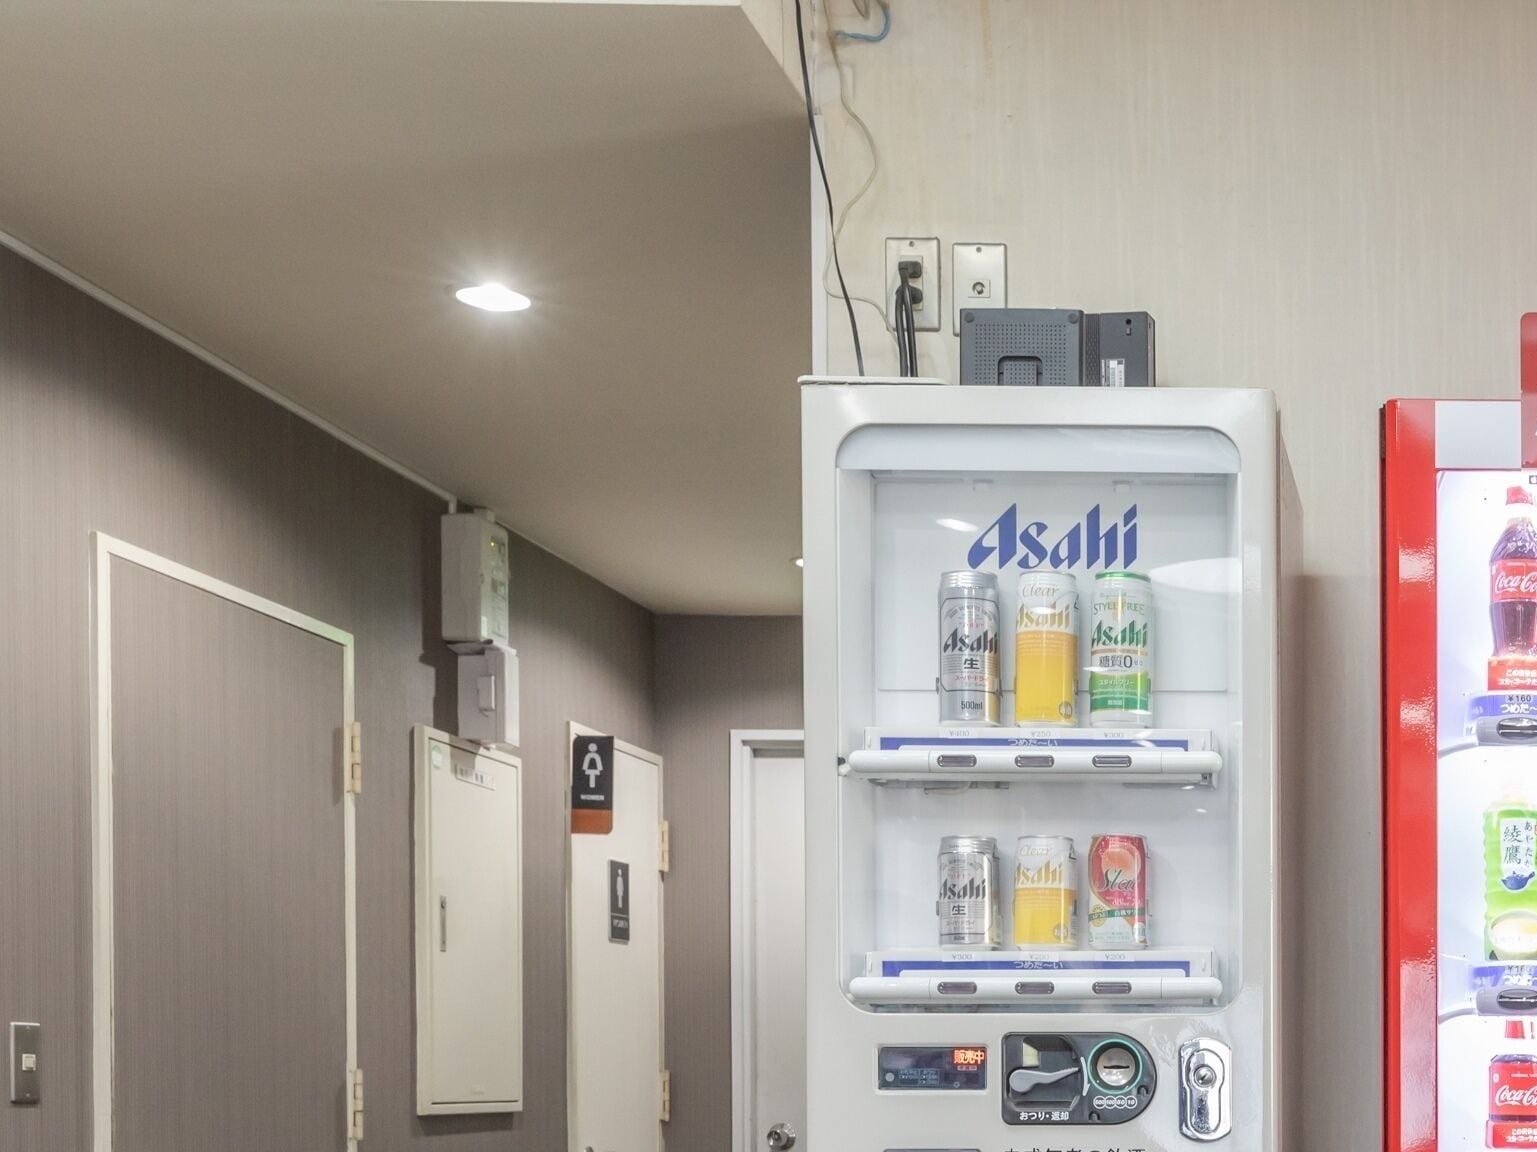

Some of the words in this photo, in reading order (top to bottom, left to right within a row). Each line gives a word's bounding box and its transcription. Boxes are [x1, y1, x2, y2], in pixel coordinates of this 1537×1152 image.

[968, 503, 1137, 569] Asahi
[1022, 584, 1059, 597] Clear
[1017, 603, 1070, 628] Asahi
[943, 628, 998, 654] Asahi
[1092, 620, 1148, 648] Asahi
[964, 658, 980, 670] 生
[961, 701, 983, 710] 500ml
[1504, 825, 1523, 866] 綾鷹
[952, 905, 967, 916] 生
[954, 1050, 985, 1065] 販売中
[1019, 1112, 1069, 1120] おつり・返却
